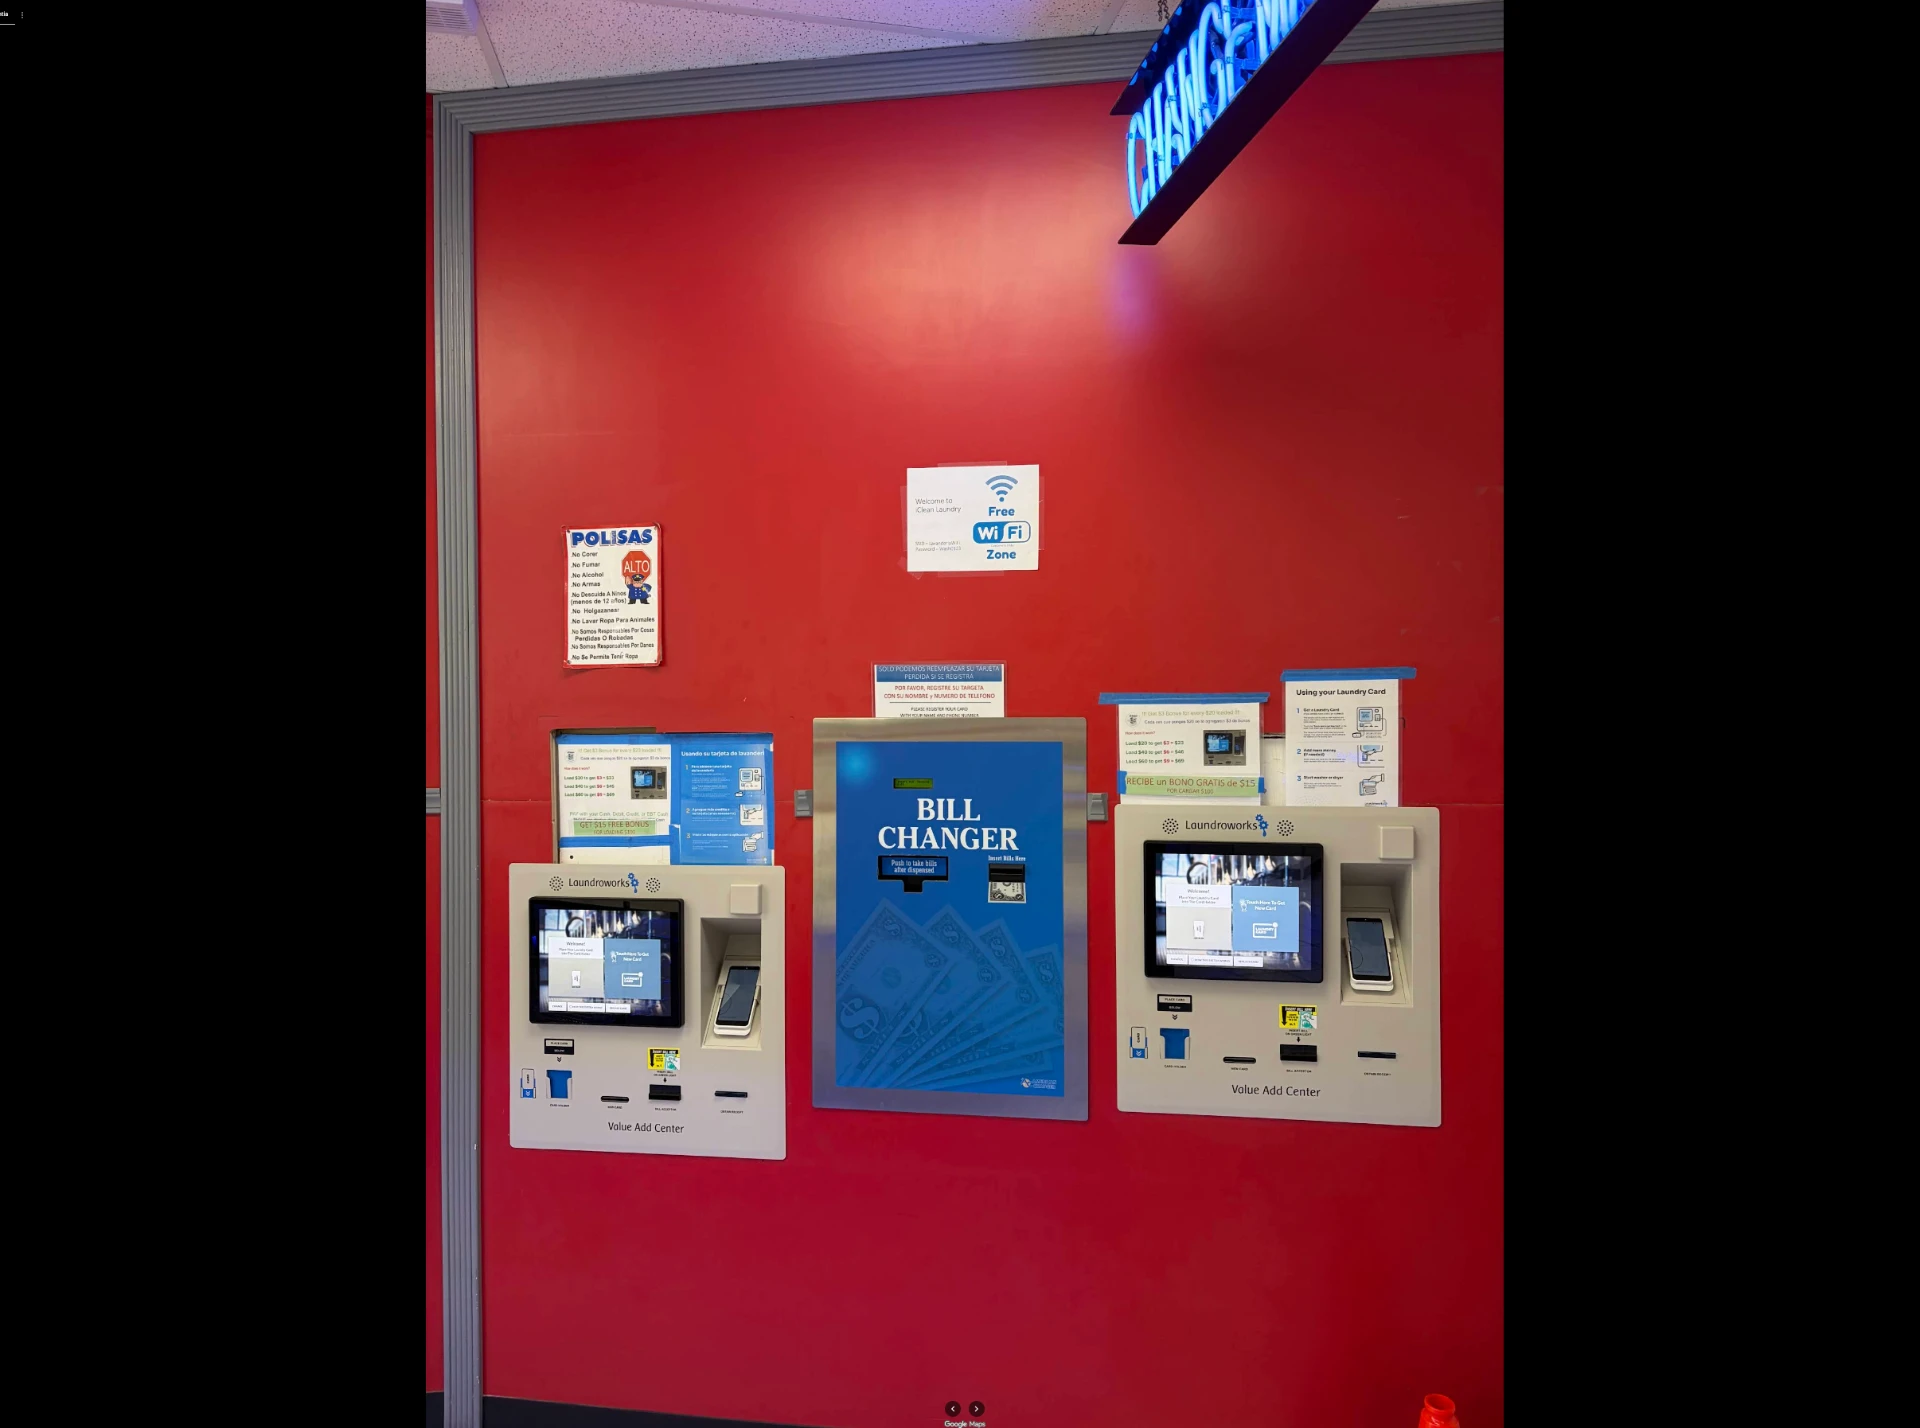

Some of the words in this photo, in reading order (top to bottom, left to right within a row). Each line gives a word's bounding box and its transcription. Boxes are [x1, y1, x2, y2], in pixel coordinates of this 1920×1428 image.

[988, 507, 1015, 516] Free
[571, 529, 652, 547] POLISAS
[978, 526, 998, 540] Wi
[1008, 526, 1022, 539] Fi
[986, 550, 1016, 559] Zone
[624, 560, 650, 573] ALTO
[917, 798, 980, 821] BILL
[1185, 820, 1257, 831] Laundroworks
[878, 826, 1019, 850] CHANGER
[569, 878, 630, 888] Laundroworks
[1231, 1084, 1260, 1095] Value
[1263, 1085, 1283, 1096] Add
[1286, 1086, 1321, 1097] Center
[608, 1121, 632, 1132] Value
[634, 1122, 652, 1132] Add
[654, 1123, 684, 1133] Center
